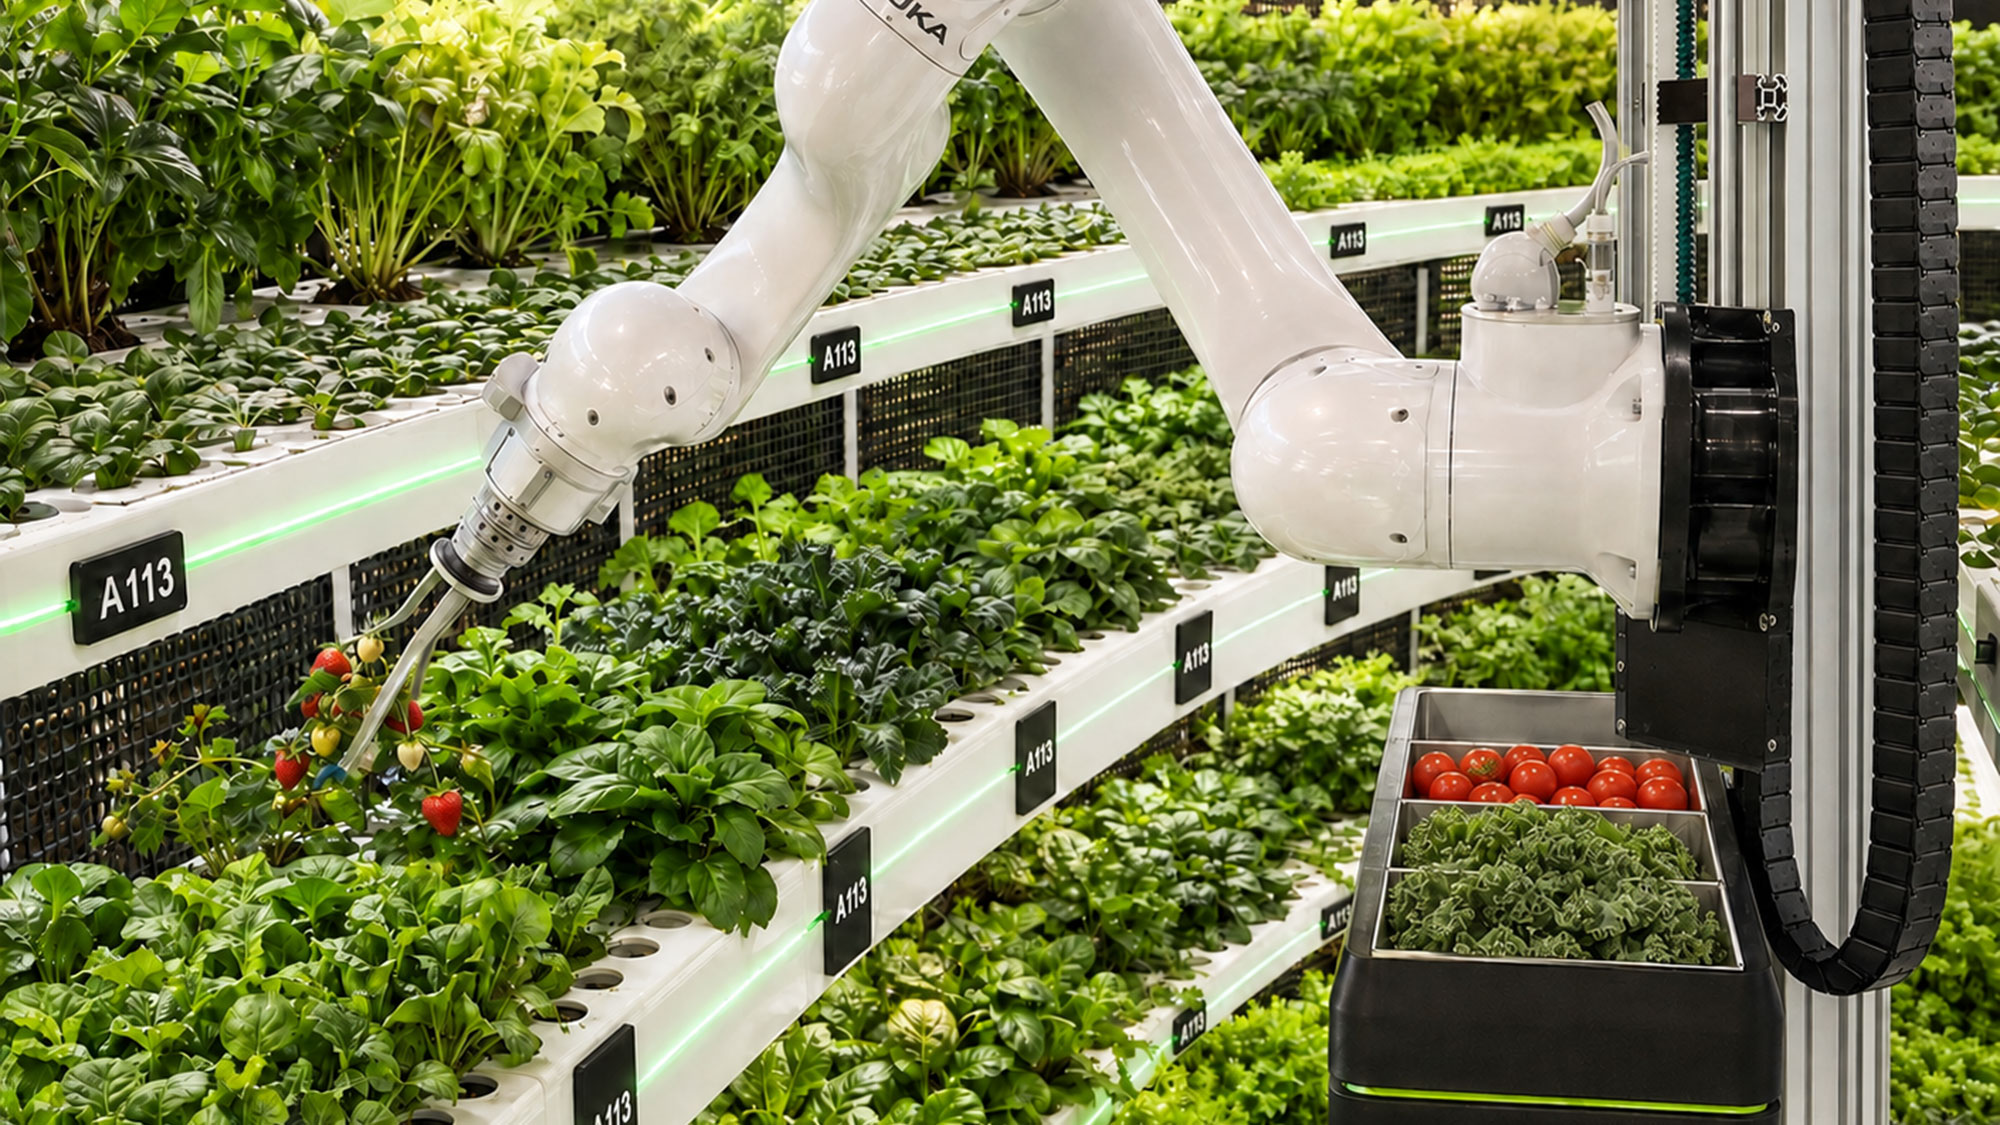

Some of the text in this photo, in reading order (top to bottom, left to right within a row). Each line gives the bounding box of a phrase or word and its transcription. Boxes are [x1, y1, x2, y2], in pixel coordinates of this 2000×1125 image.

[1492, 211, 1521, 232] A113
[1337, 229, 1364, 251] A113
[1022, 289, 1052, 316] A113
[823, 339, 857, 372] A113
[99, 557, 175, 621] A113
[1332, 575, 1358, 602] A113
[1183, 642, 1209, 673] A113
[1025, 739, 1053, 777] A113
[835, 876, 868, 924] A113
[1180, 1011, 1204, 1046] A113
